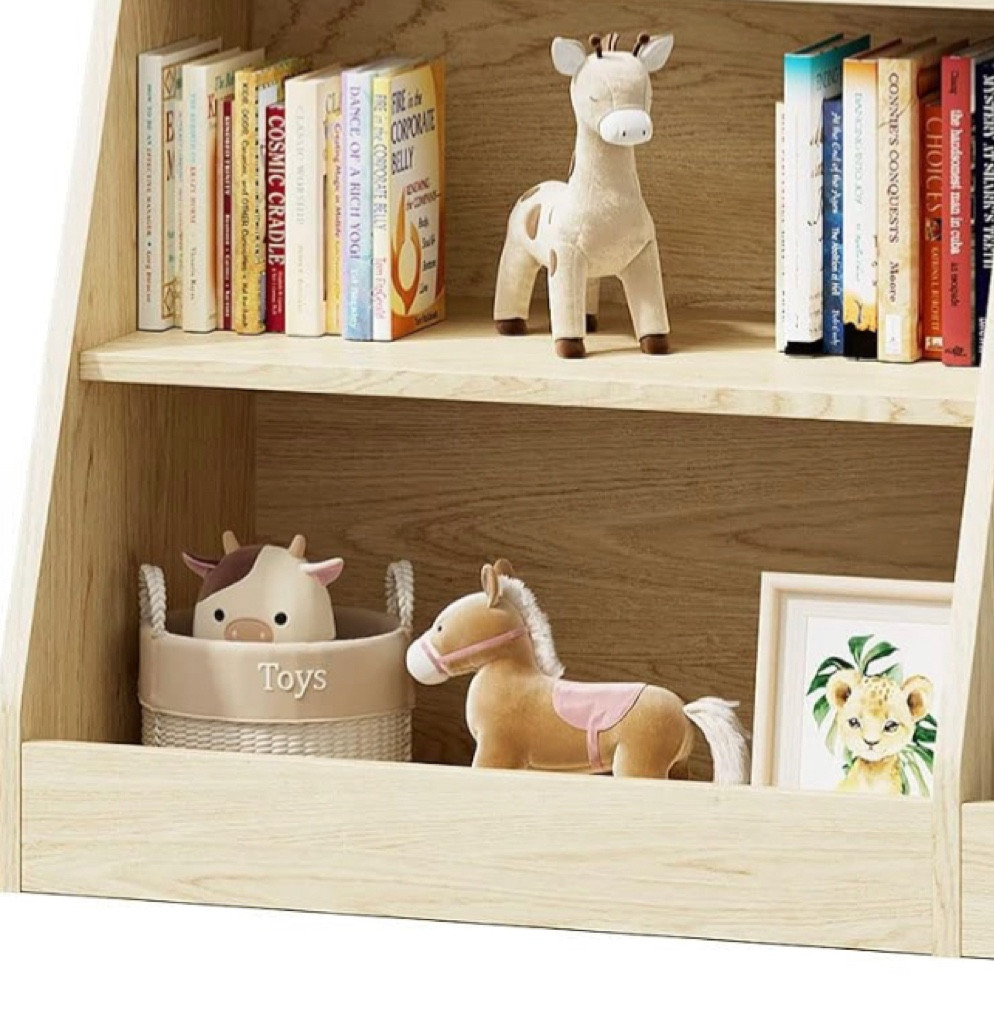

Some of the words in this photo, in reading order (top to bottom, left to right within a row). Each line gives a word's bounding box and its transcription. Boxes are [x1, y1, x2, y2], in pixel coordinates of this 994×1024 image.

[349, 85, 361, 137] DANCE
[391, 107, 436, 145] CORPORATE
[888, 71, 901, 147] CONNIE'S
[949, 108, 963, 127] the
[267, 114, 286, 187] COSMIC
[349, 141, 361, 160] OF
[391, 145, 415, 176] BELLY
[925, 116, 944, 214] CHOICES
[349, 167, 361, 177] A
[373, 143, 388, 199] CORPORATE
[349, 182, 361, 218] RICH
[886, 149, 901, 244] CONQUESTS
[949, 191, 962, 216] man
[267, 191, 286, 266] CRADLE
[373, 202, 388, 233] BELLY
[949, 217, 963, 228] in
[349, 222, 361, 260] YOGI
[888, 261, 900, 303] Moore
[257, 662, 328, 700] Toys
